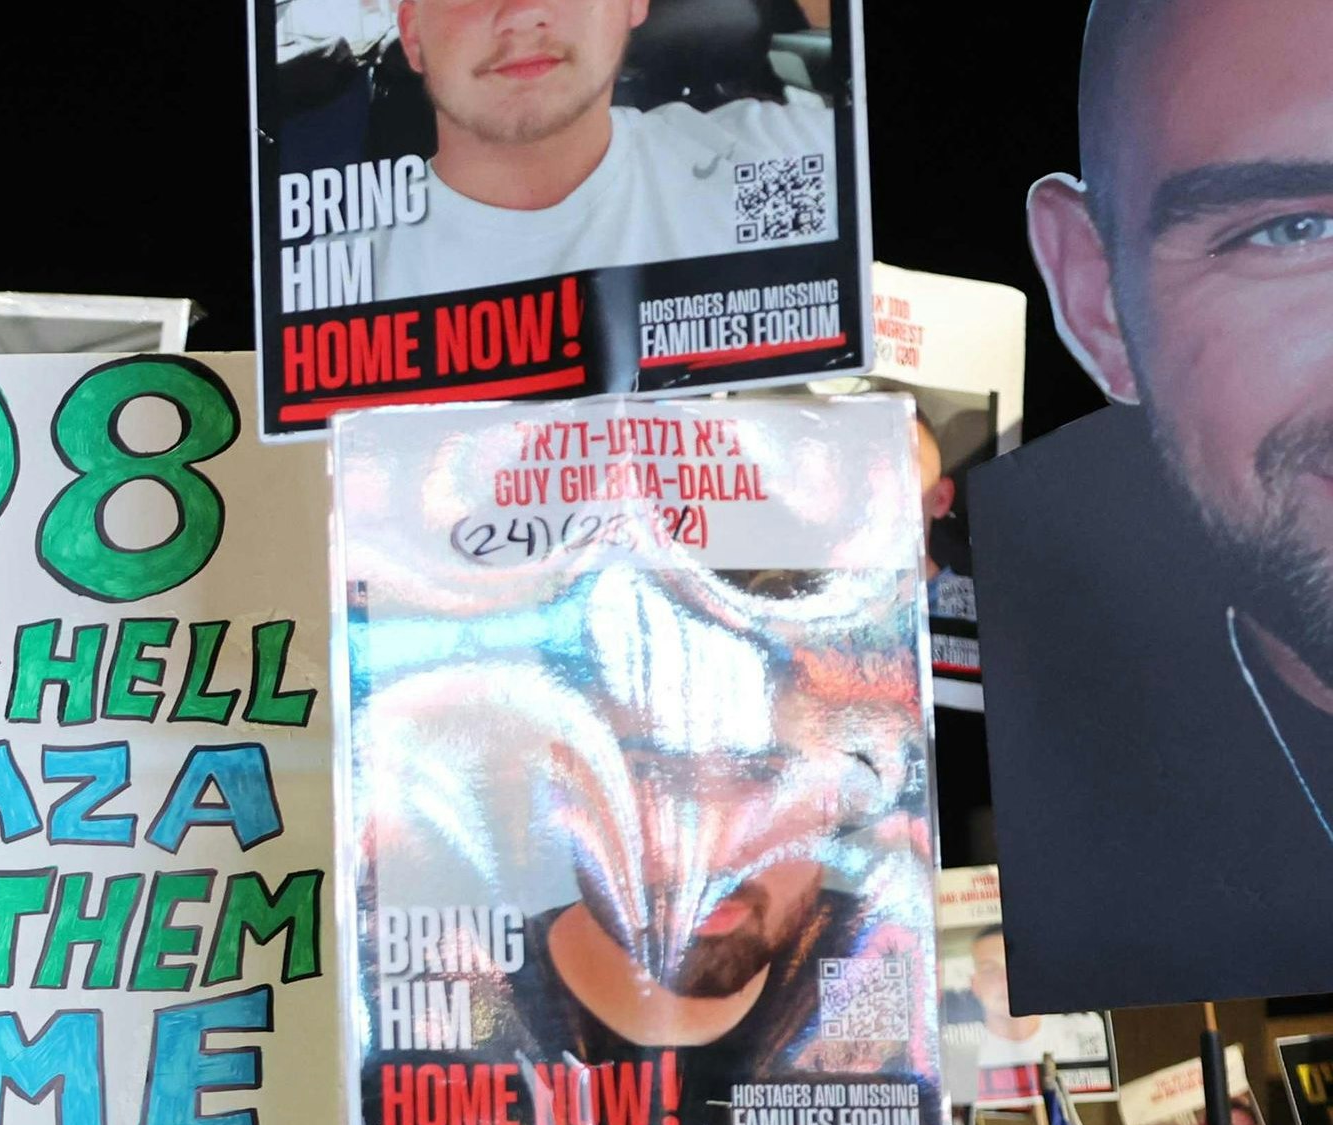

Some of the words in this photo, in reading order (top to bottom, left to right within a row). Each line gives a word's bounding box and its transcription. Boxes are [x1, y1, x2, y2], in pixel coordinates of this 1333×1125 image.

[279, 154, 430, 241] BRING
[280, 241, 376, 313] HIM
[639, 296, 726, 324] HOSTAGES
[727, 290, 761, 315] AND
[764, 280, 838, 309] MISSING
[283, 310, 420, 394] HOME
[434, 277, 581, 375] NOW!
[640, 317, 749, 360] FAMILIES
[752, 305, 840, 347] FORUM
[495, 467, 549, 507] GUY
[6, 617, 318, 729] HELL
[380, 904, 526, 976] BRING
[380, 979, 472, 1051] HIM
[732, 1083, 810, 1108] HOSTAGES
[814, 1083, 845, 1107] AND
[849, 1083, 919, 1107] MISSING
